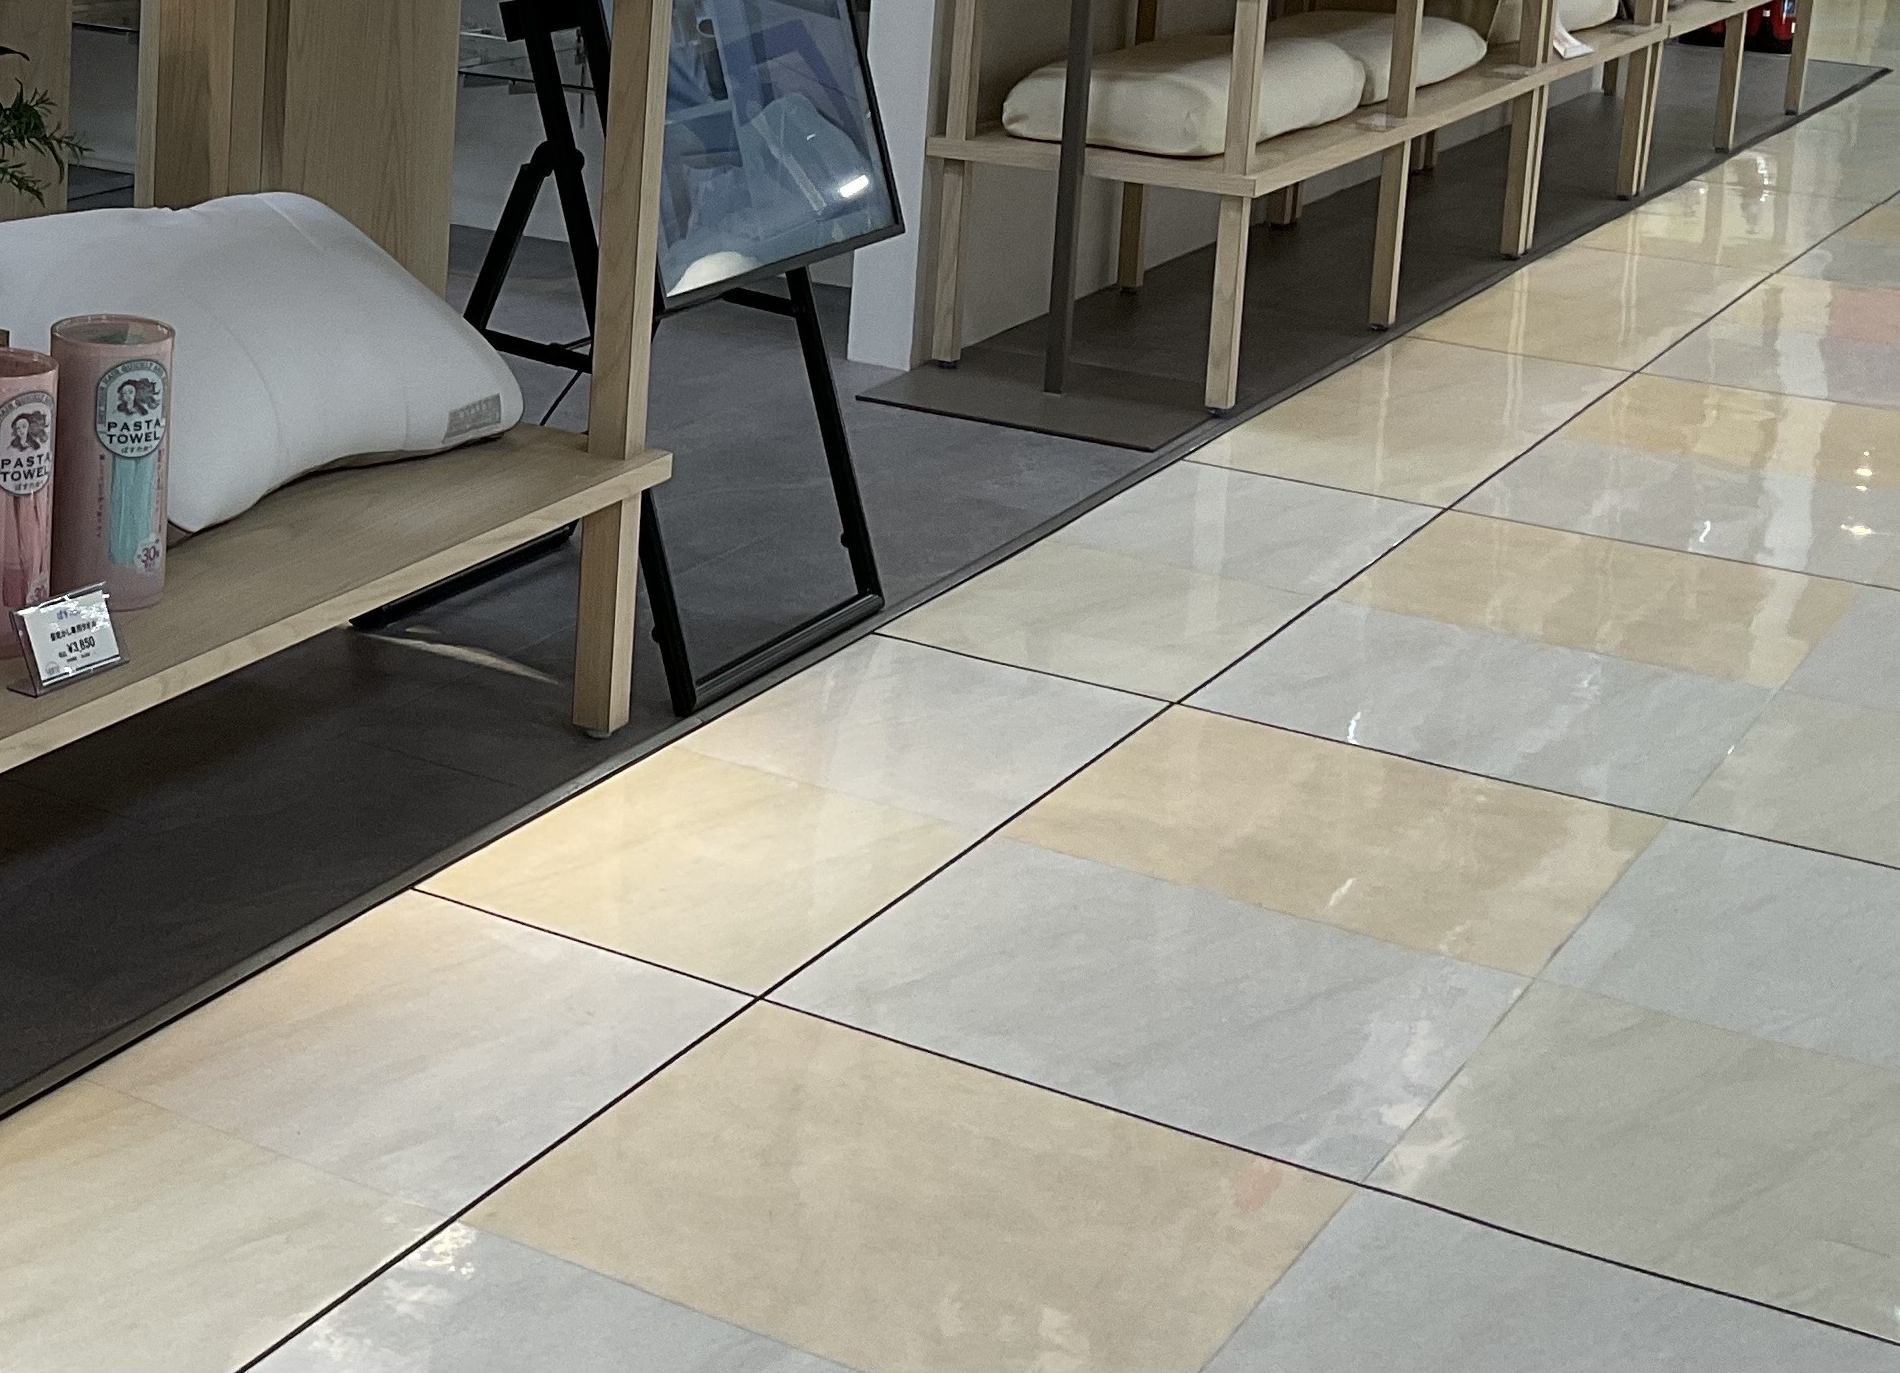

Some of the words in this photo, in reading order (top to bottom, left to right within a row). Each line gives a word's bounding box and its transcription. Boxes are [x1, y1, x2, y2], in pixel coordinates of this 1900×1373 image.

[107, 417, 161, 432] PASTA
[106, 430, 161, 445] TOWEL
[0, 453, 51, 470] PASTA
[0, 467, 50, 482] TOWEL
[66, 635, 96, 654] ¥3,850
